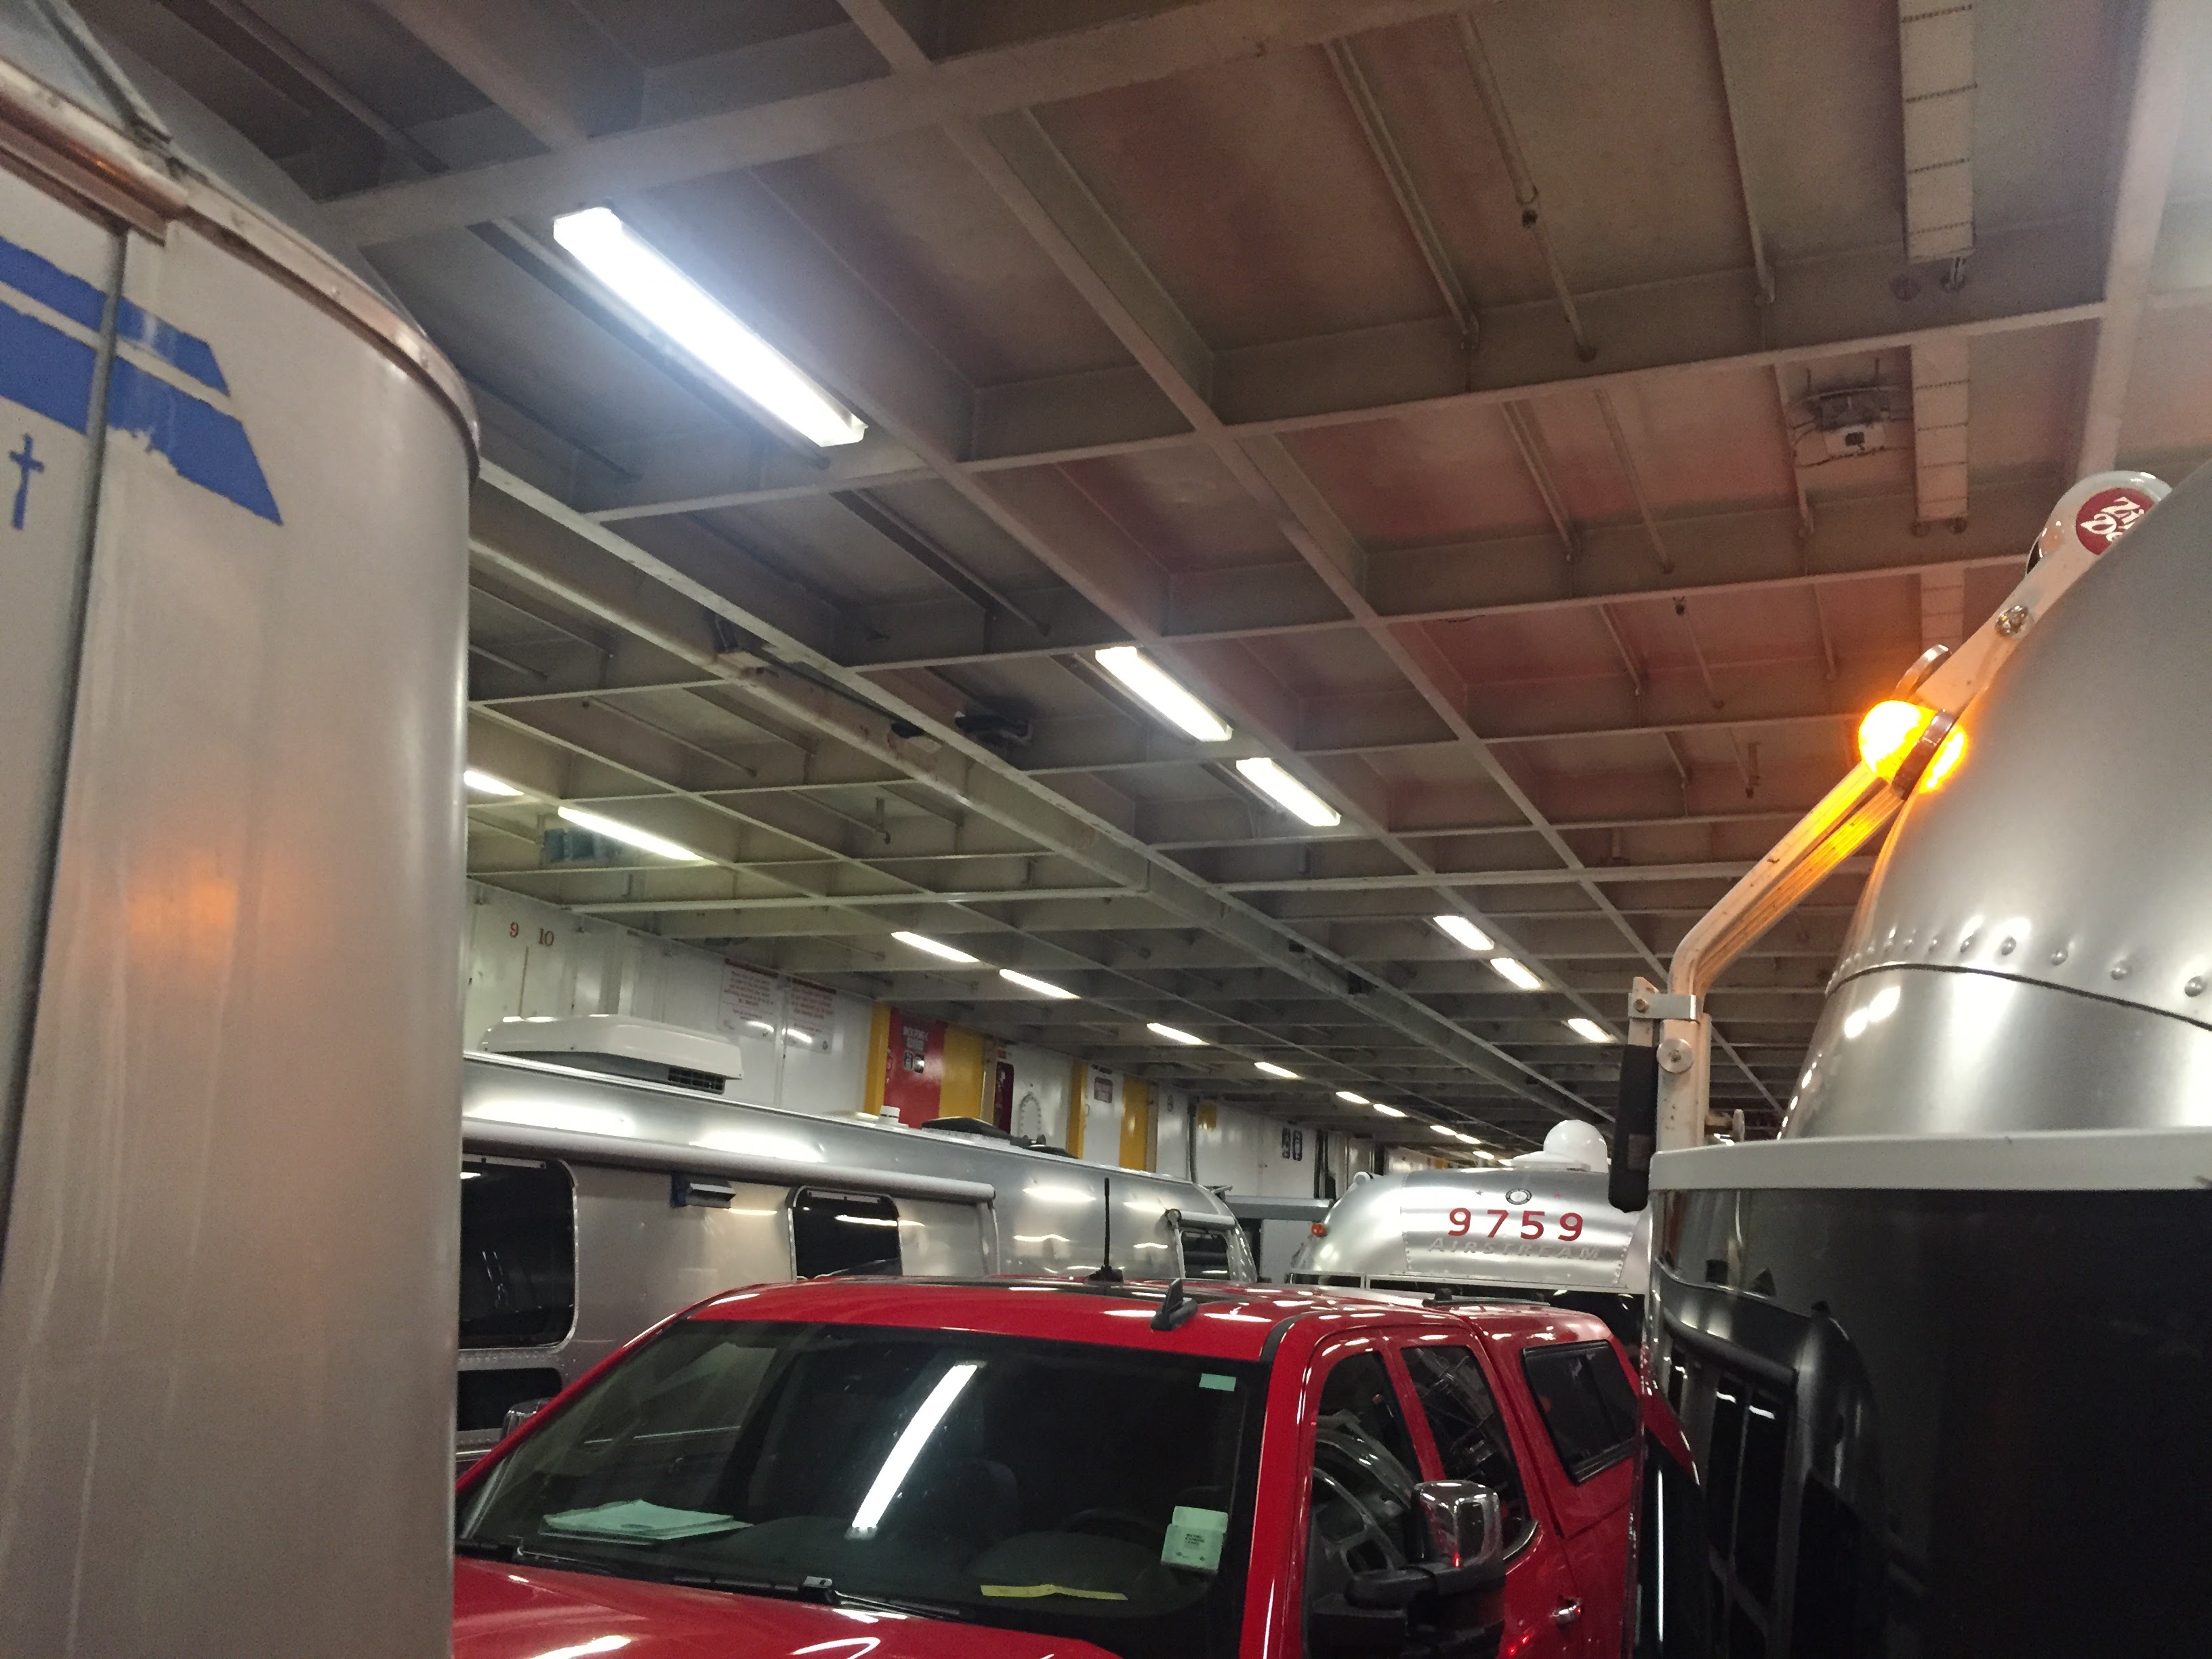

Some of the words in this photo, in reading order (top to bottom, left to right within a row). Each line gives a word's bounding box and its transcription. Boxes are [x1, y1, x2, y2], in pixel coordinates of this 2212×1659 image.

[2080, 513, 2123, 541] De
[510, 922, 519, 938] 9
[538, 928, 554, 946] 10
[1448, 1208, 1583, 1241] 9759
[1427, 1237, 1600, 1261] AIRSTREAM
